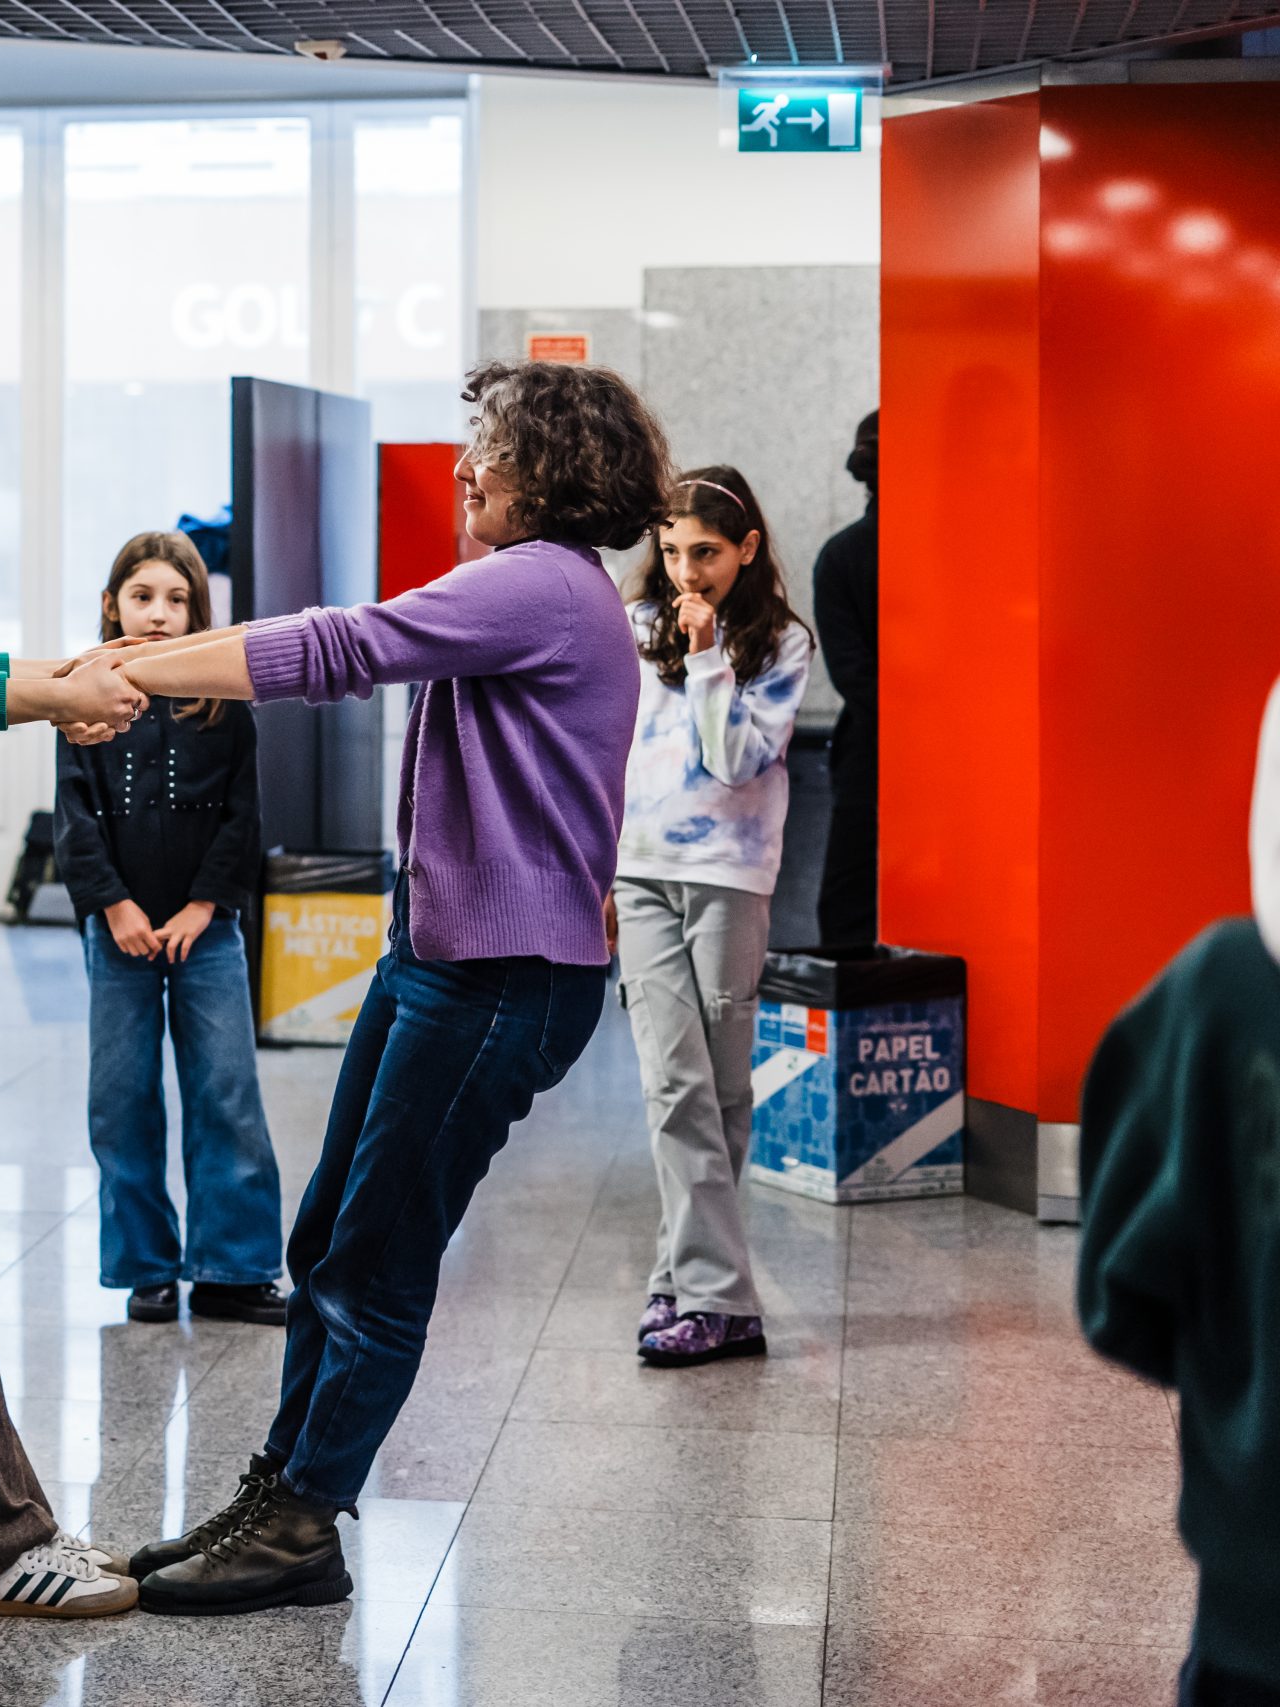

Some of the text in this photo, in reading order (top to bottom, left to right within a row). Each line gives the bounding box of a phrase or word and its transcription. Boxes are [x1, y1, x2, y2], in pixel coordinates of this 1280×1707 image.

[171, 282, 374, 349] GOL
[270, 902, 377, 937] PLÁSTICO
[284, 936, 360, 960] METAL
[858, 1034, 940, 1063] PAPEL
[850, 1061, 950, 1097] CARTÃO
